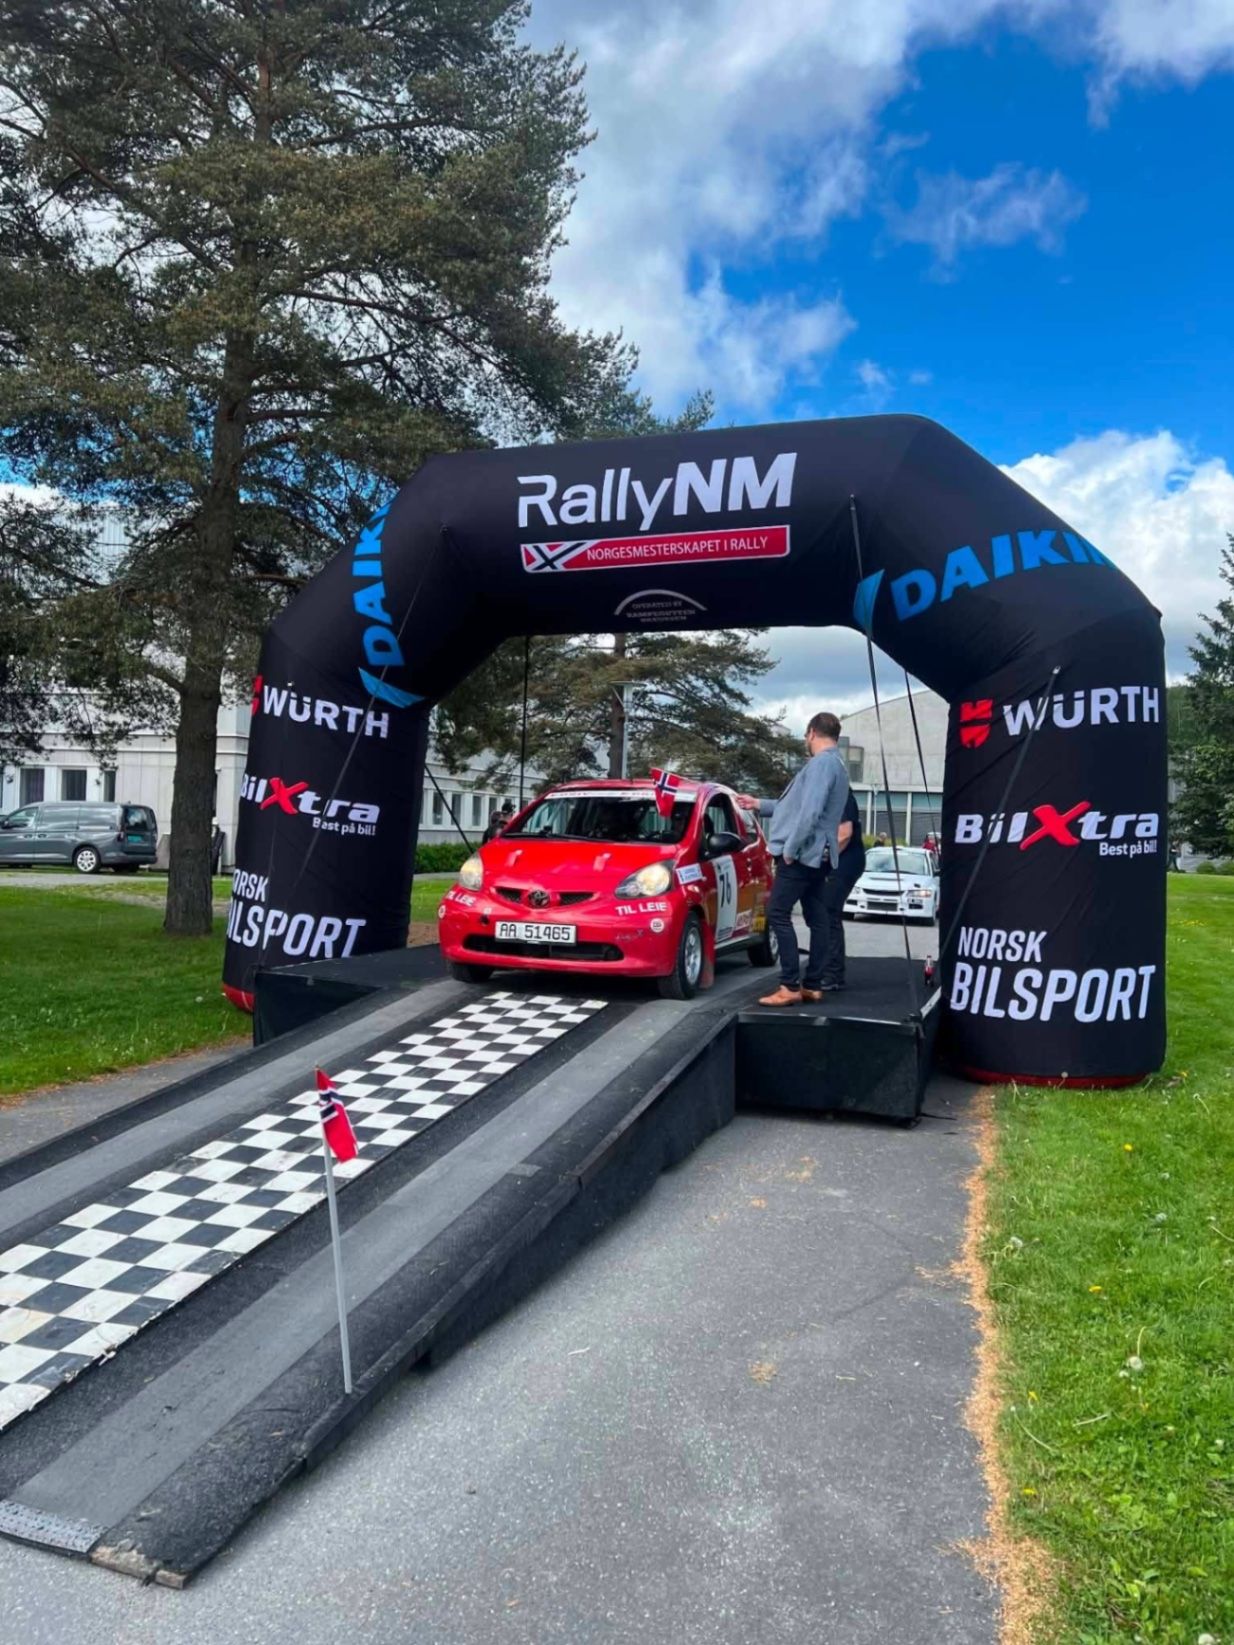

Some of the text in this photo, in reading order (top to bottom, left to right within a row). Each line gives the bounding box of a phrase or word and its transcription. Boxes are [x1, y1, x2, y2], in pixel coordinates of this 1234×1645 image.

[517, 452, 797, 531] RallyNM
[587, 536, 768, 561] NORGESMESTERSKAPET I RALLY
[353, 502, 405, 666] DAIK
[263, 685, 390, 738] WÜRTH
[1003, 686, 1159, 736] WÜRTH
[341, 822, 356, 836] på
[1099, 841, 1128, 856] Best
[1130, 840, 1142, 859] på
[232, 868, 269, 902] ORSK
[615, 901, 668, 916] TIL LEIE
[226, 898, 367, 958] ILSPORT
[500, 923, 571, 941] AA 51465
[957, 926, 1047, 962] NORSK
[949, 962, 1156, 1023] BILSPORT
